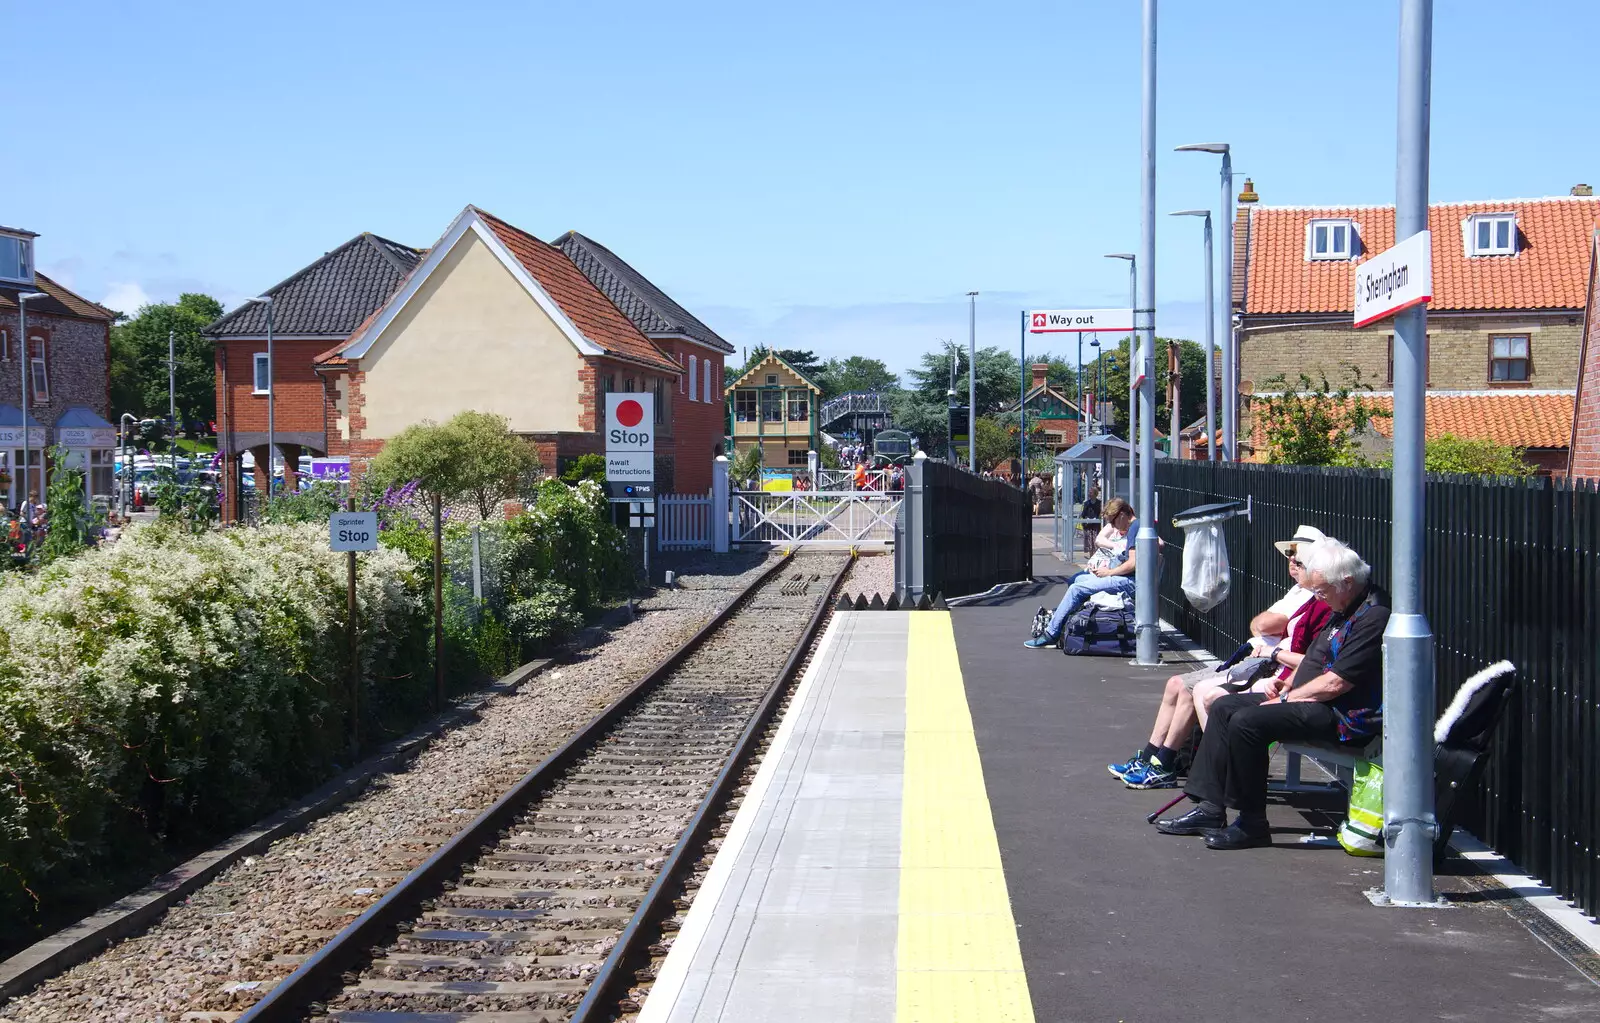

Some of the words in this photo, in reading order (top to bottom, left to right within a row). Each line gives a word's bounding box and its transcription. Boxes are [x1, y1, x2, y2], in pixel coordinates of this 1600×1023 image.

[1366, 262, 1408, 302] Sheringham
[1049, 315, 1072, 326] Way
[1076, 315, 1094, 324] out
[610, 430, 649, 446] Stop
[338, 530, 369, 543] Stop
